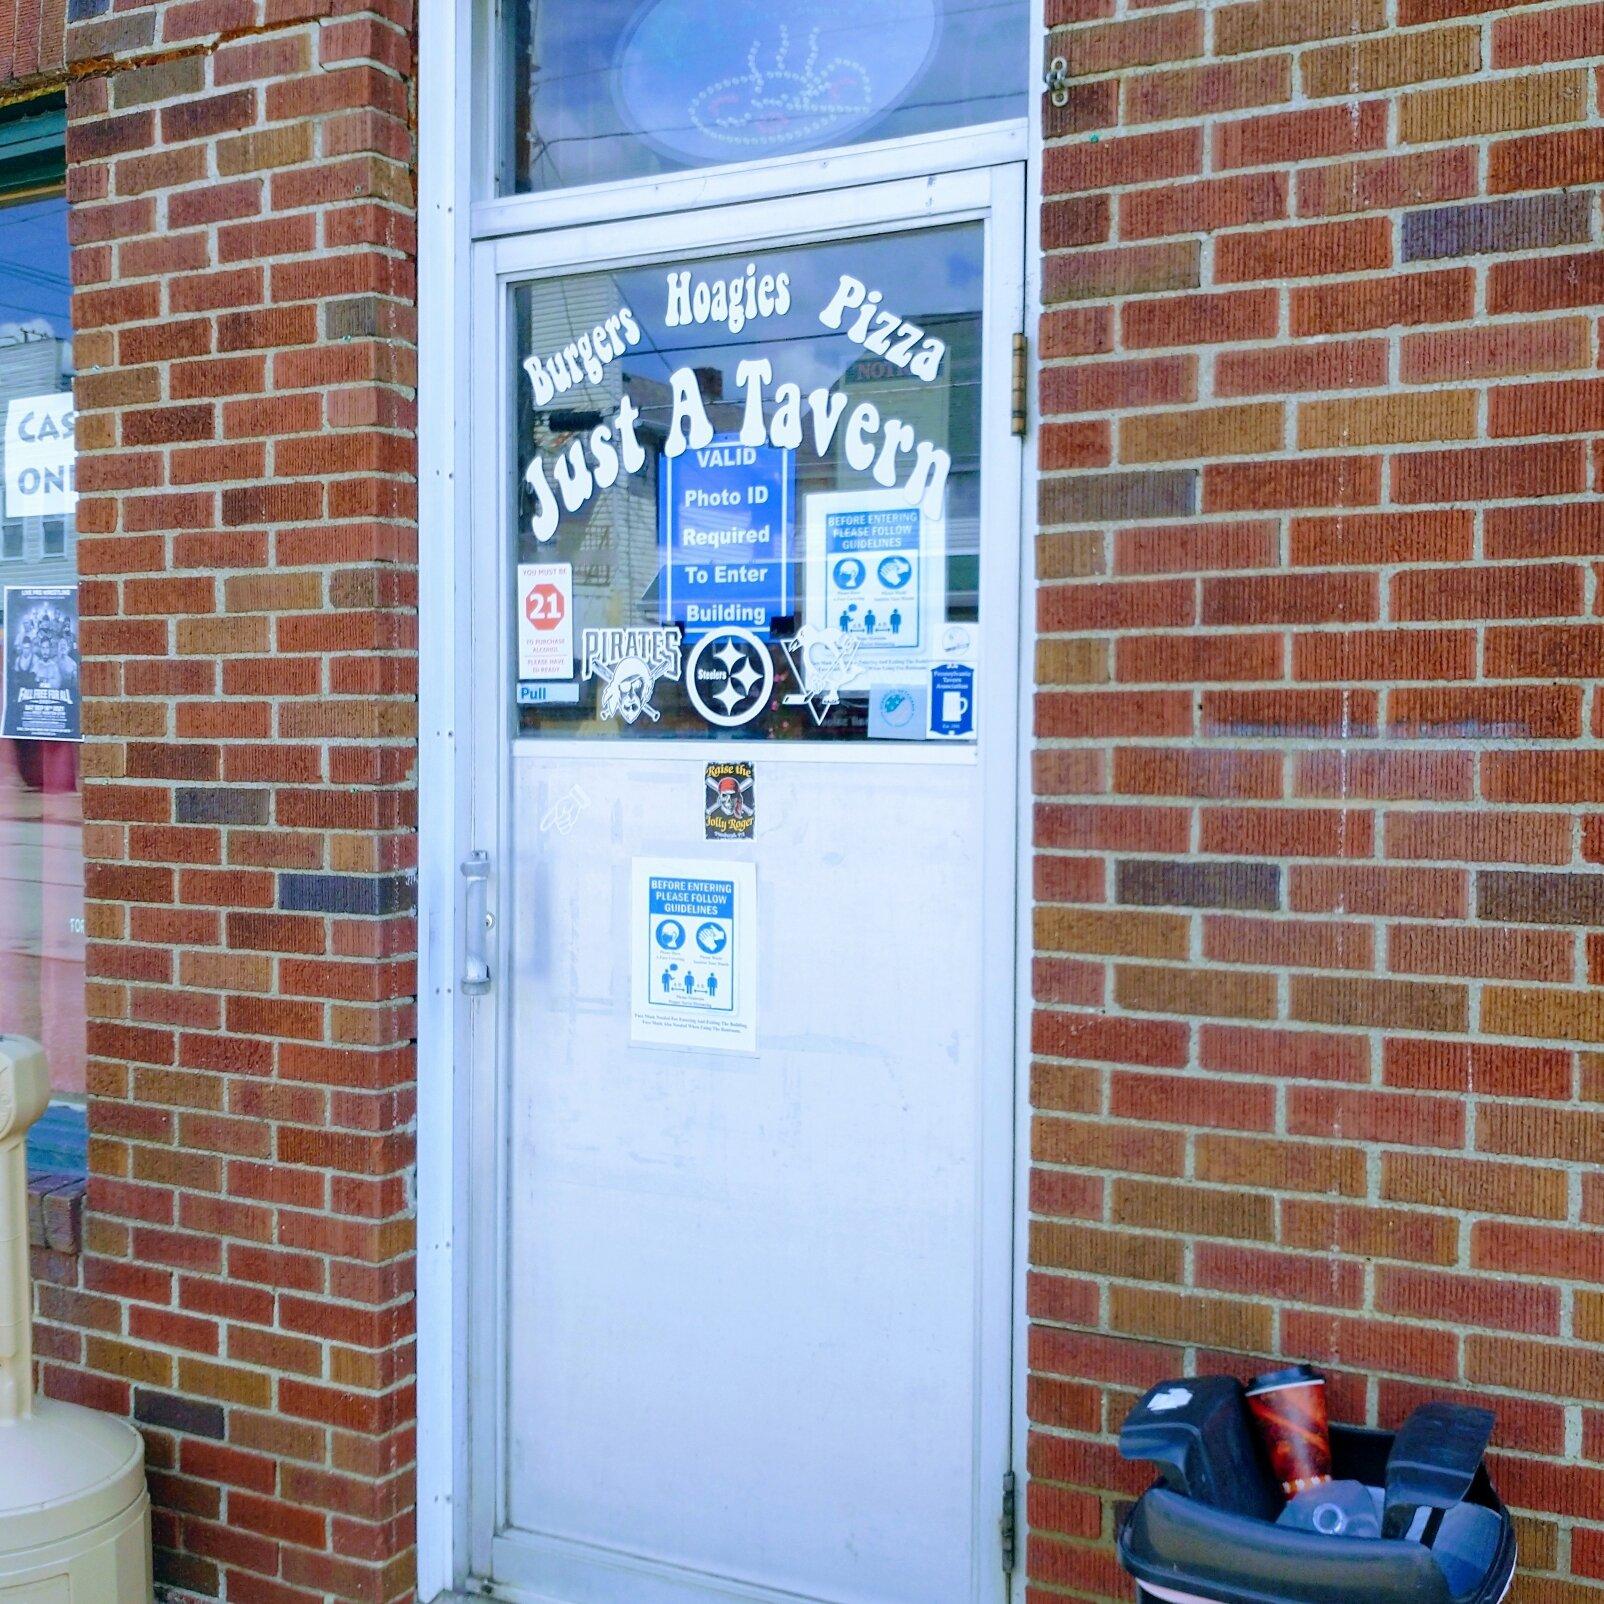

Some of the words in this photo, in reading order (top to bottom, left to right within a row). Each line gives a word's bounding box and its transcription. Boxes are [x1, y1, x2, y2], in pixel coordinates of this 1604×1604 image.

[665, 263, 791, 333] Hoagies
[818, 275, 946, 382] Pizza
[523, 307, 641, 406] Burgers
[525, 394, 646, 542] Just
[664, 367, 714, 458] A
[735, 358, 951, 521] Tavern
[697, 448, 757, 468] VALID
[684, 487, 741, 508] Photo
[748, 485, 769, 504] ID
[828, 515, 866, 527] BEFORE
[868, 512, 917, 524] ENTERING
[683, 525, 770, 549] Required
[833, 527, 869, 538] PLEASE
[871, 525, 912, 536] FOLLOW
[842, 538, 902, 550] GUIDELINES
[523, 568, 537, 577] YOU
[538, 567, 557, 577] MUST
[685, 566, 708, 584] To
[714, 566, 768, 583] Enter
[530, 592, 562, 619] 21
[686, 604, 766, 626] Building
[582, 627, 682, 681] PIRATES
[697, 669, 727, 681] Steelers
[521, 687, 546, 700] Pull
[706, 765, 734, 777] Raise
[735, 764, 752, 777] the
[706, 816, 727, 832] Jolly
[728, 818, 753, 832] Roger
[651, 879, 686, 892] BEFORE
[688, 882, 732, 894] ENTERING
[655, 891, 690, 903] PLEASE
[691, 893, 727, 905] FOLLOW
[664, 903, 718, 915] GUIDELINES
